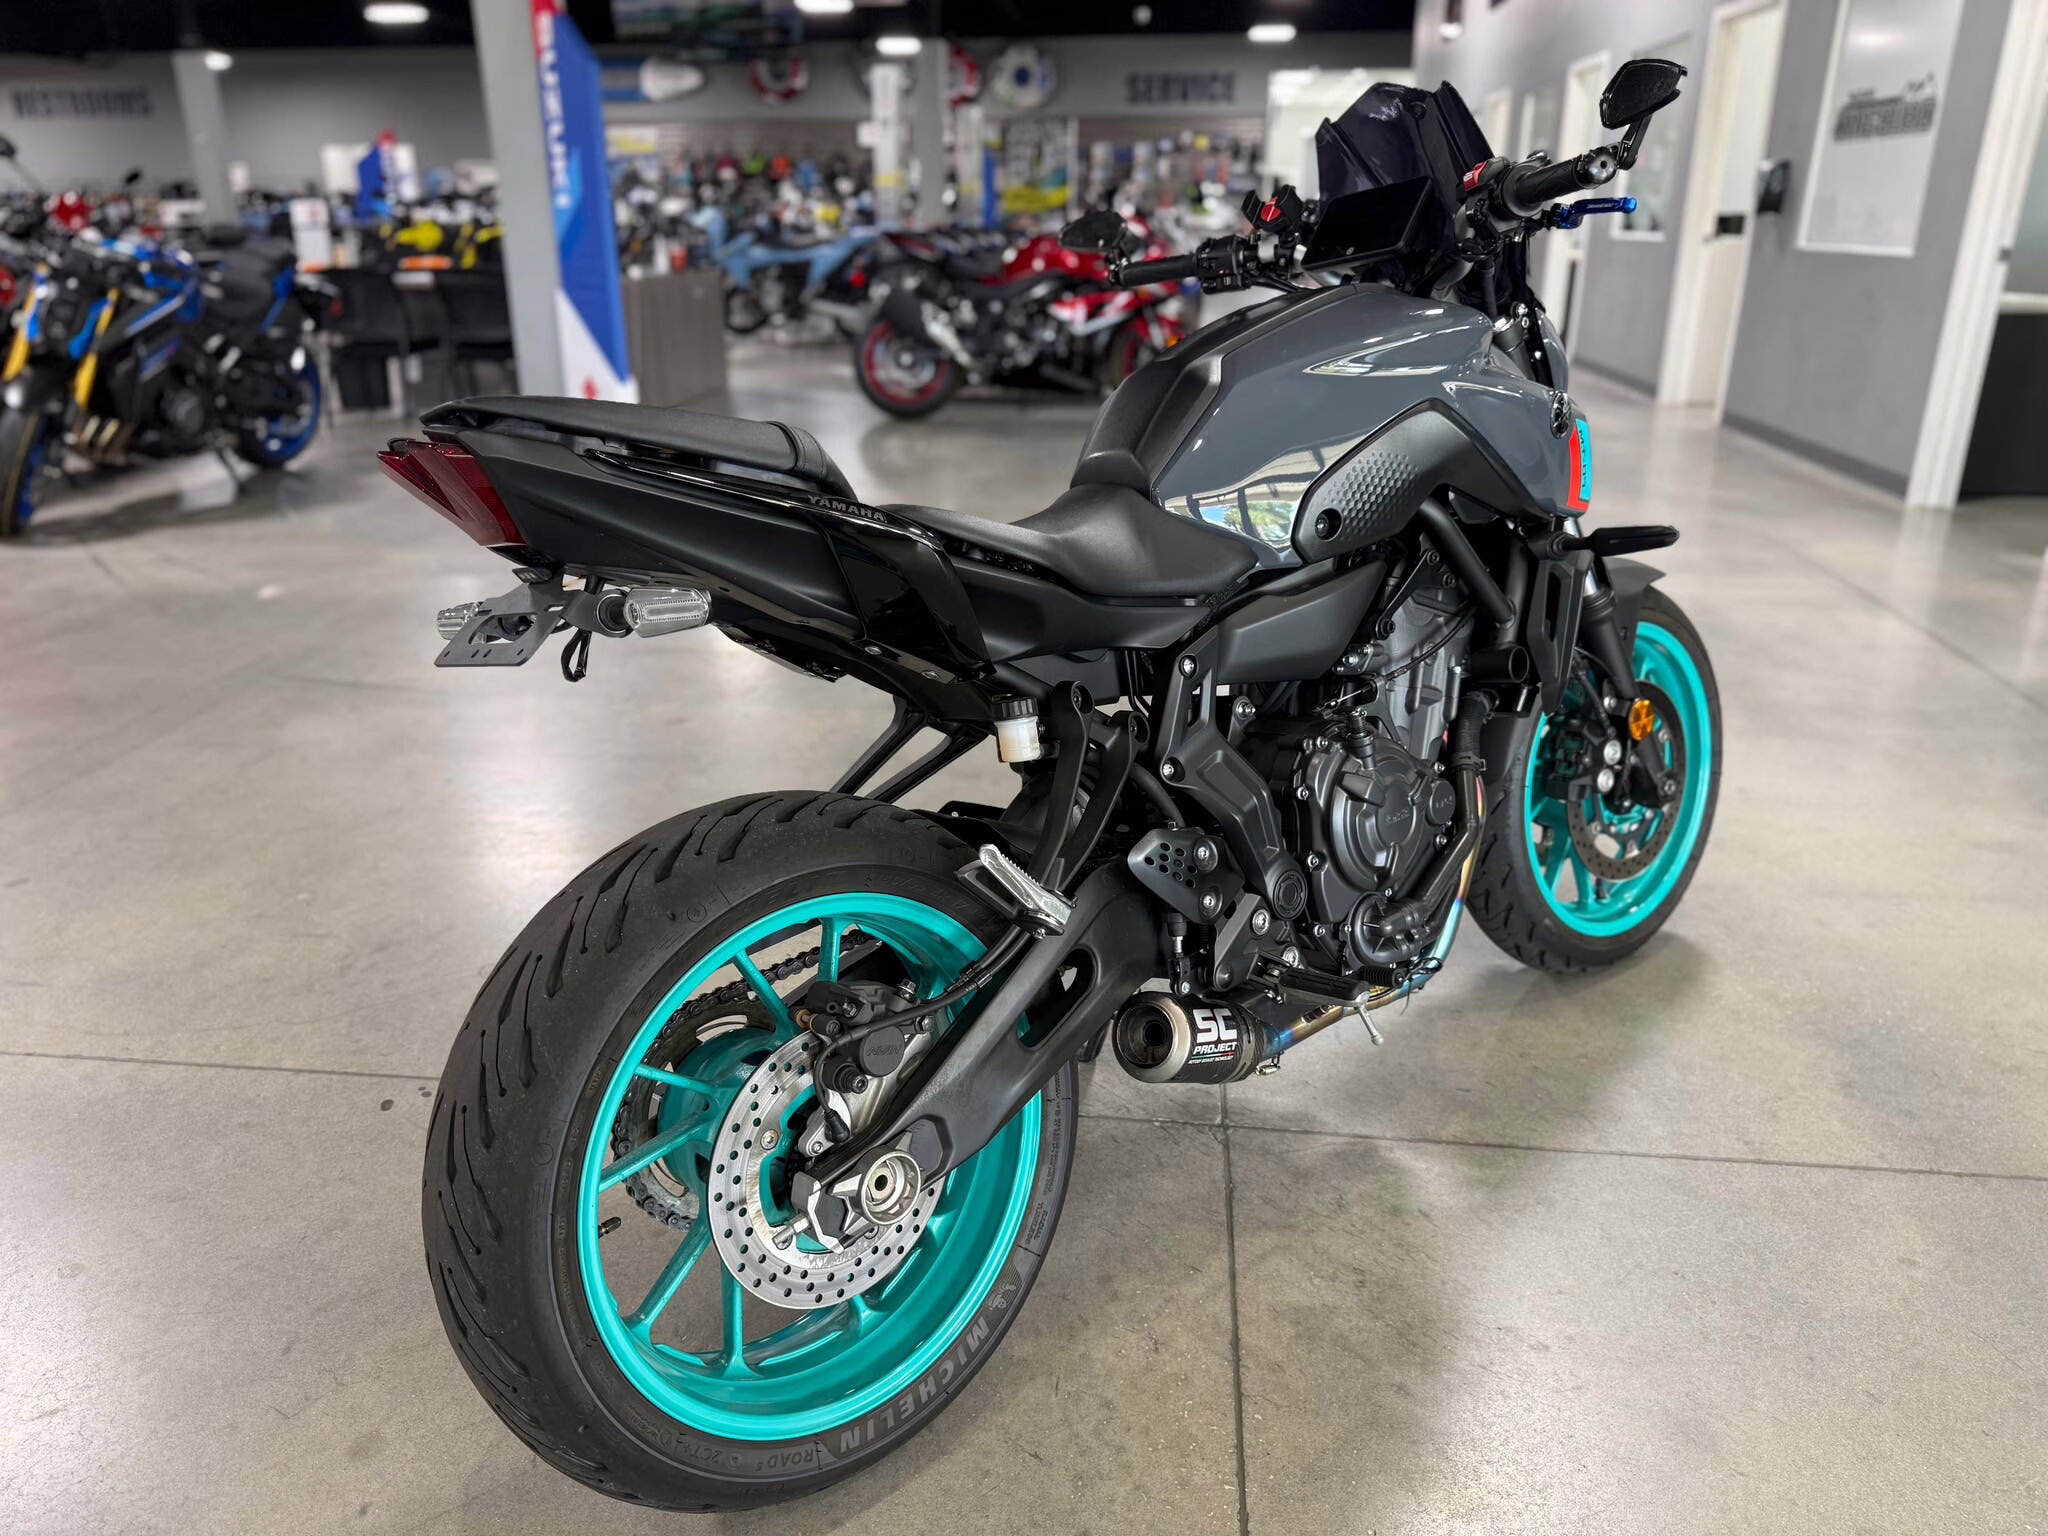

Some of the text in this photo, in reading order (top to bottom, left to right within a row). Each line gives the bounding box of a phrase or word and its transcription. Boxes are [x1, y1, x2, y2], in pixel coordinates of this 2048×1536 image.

[1126, 71, 1236, 105] SERVICE
[807, 494, 887, 523] YAMAHA
[1193, 1008, 1238, 1043] SC
[1193, 1041, 1238, 1055] PROJECT
[839, 1316, 990, 1454] MICHELIN
[768, 1449, 815, 1467] ROAD
